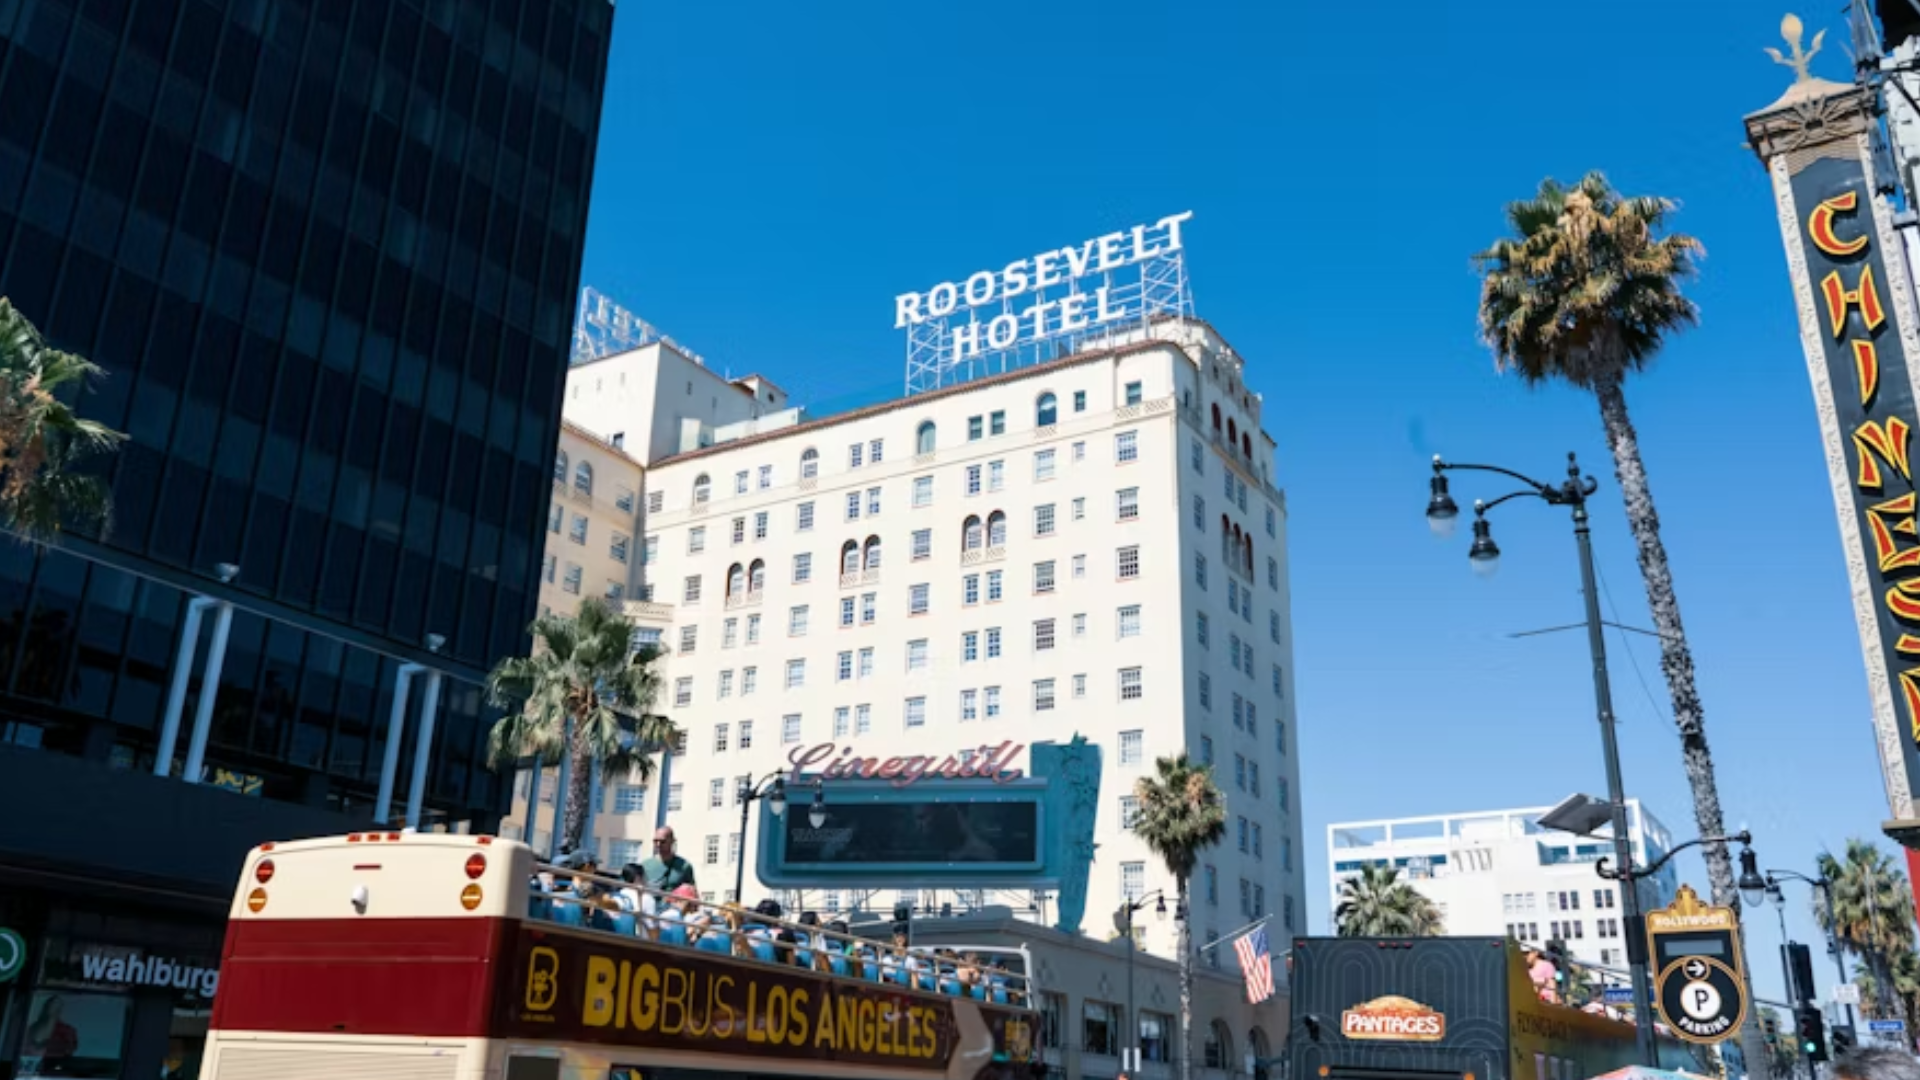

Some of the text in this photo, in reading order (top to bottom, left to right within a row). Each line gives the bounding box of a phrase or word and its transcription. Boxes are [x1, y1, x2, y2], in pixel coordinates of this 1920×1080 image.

[894, 210, 1193, 329] ROOSEVELT
[951, 286, 1126, 365] HOTEL
[787, 739, 1026, 788] Cinegrill
[1653, 914, 1727, 927] HOLLYWOOD
[1694, 988, 1710, 1012] P
[746, 981, 809, 1046] LOS
[814, 992, 937, 1059] ANGELES
[1346, 1013, 1441, 1035] PANTAGES
[1678, 1015, 1731, 1035] PARKING
